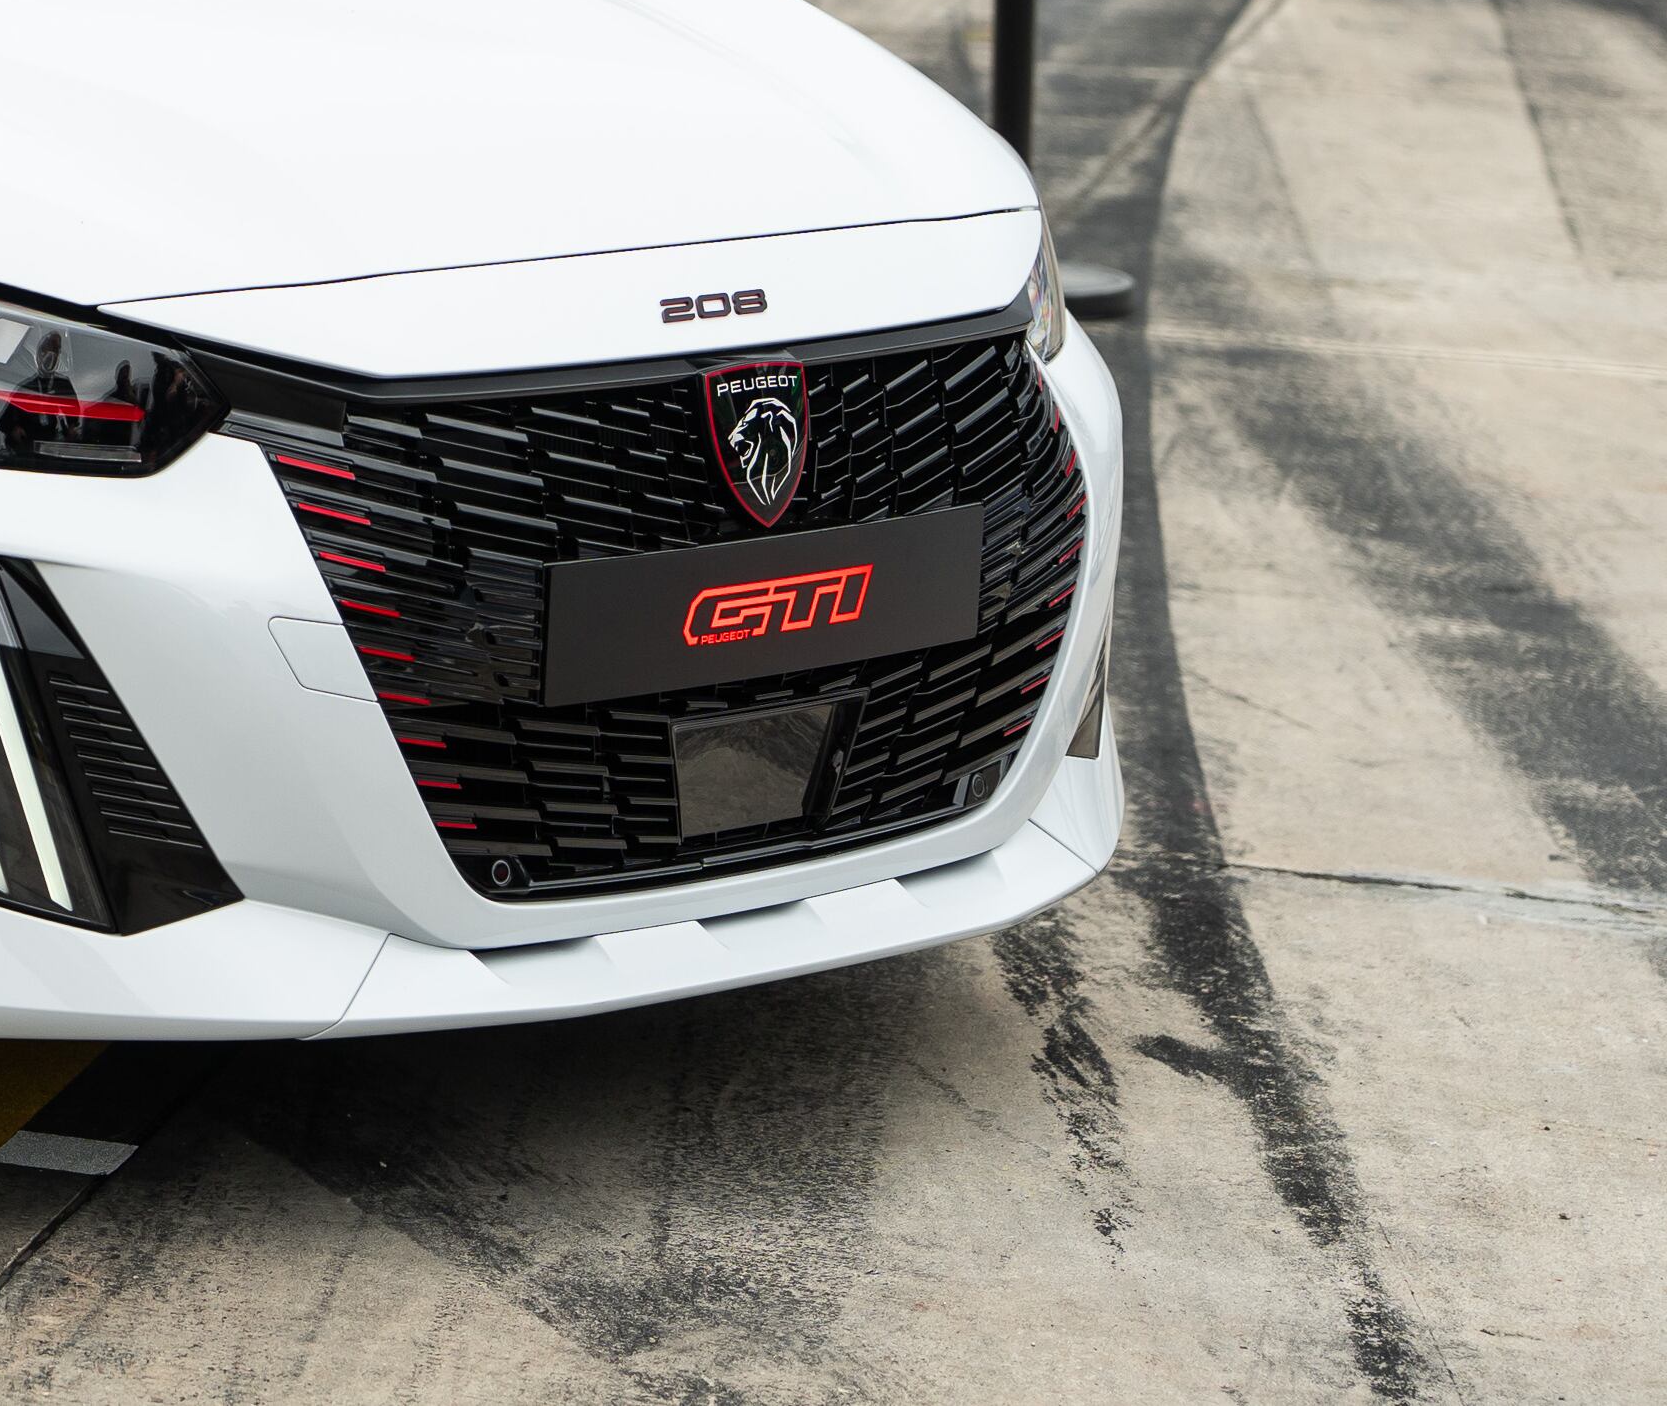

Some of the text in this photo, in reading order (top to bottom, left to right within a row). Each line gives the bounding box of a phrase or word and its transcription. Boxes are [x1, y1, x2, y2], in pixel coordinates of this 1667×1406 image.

[659, 288, 768, 324] 208
[716, 374, 799, 398] PEUGEOT
[700, 628, 752, 646] PEUGEOT
